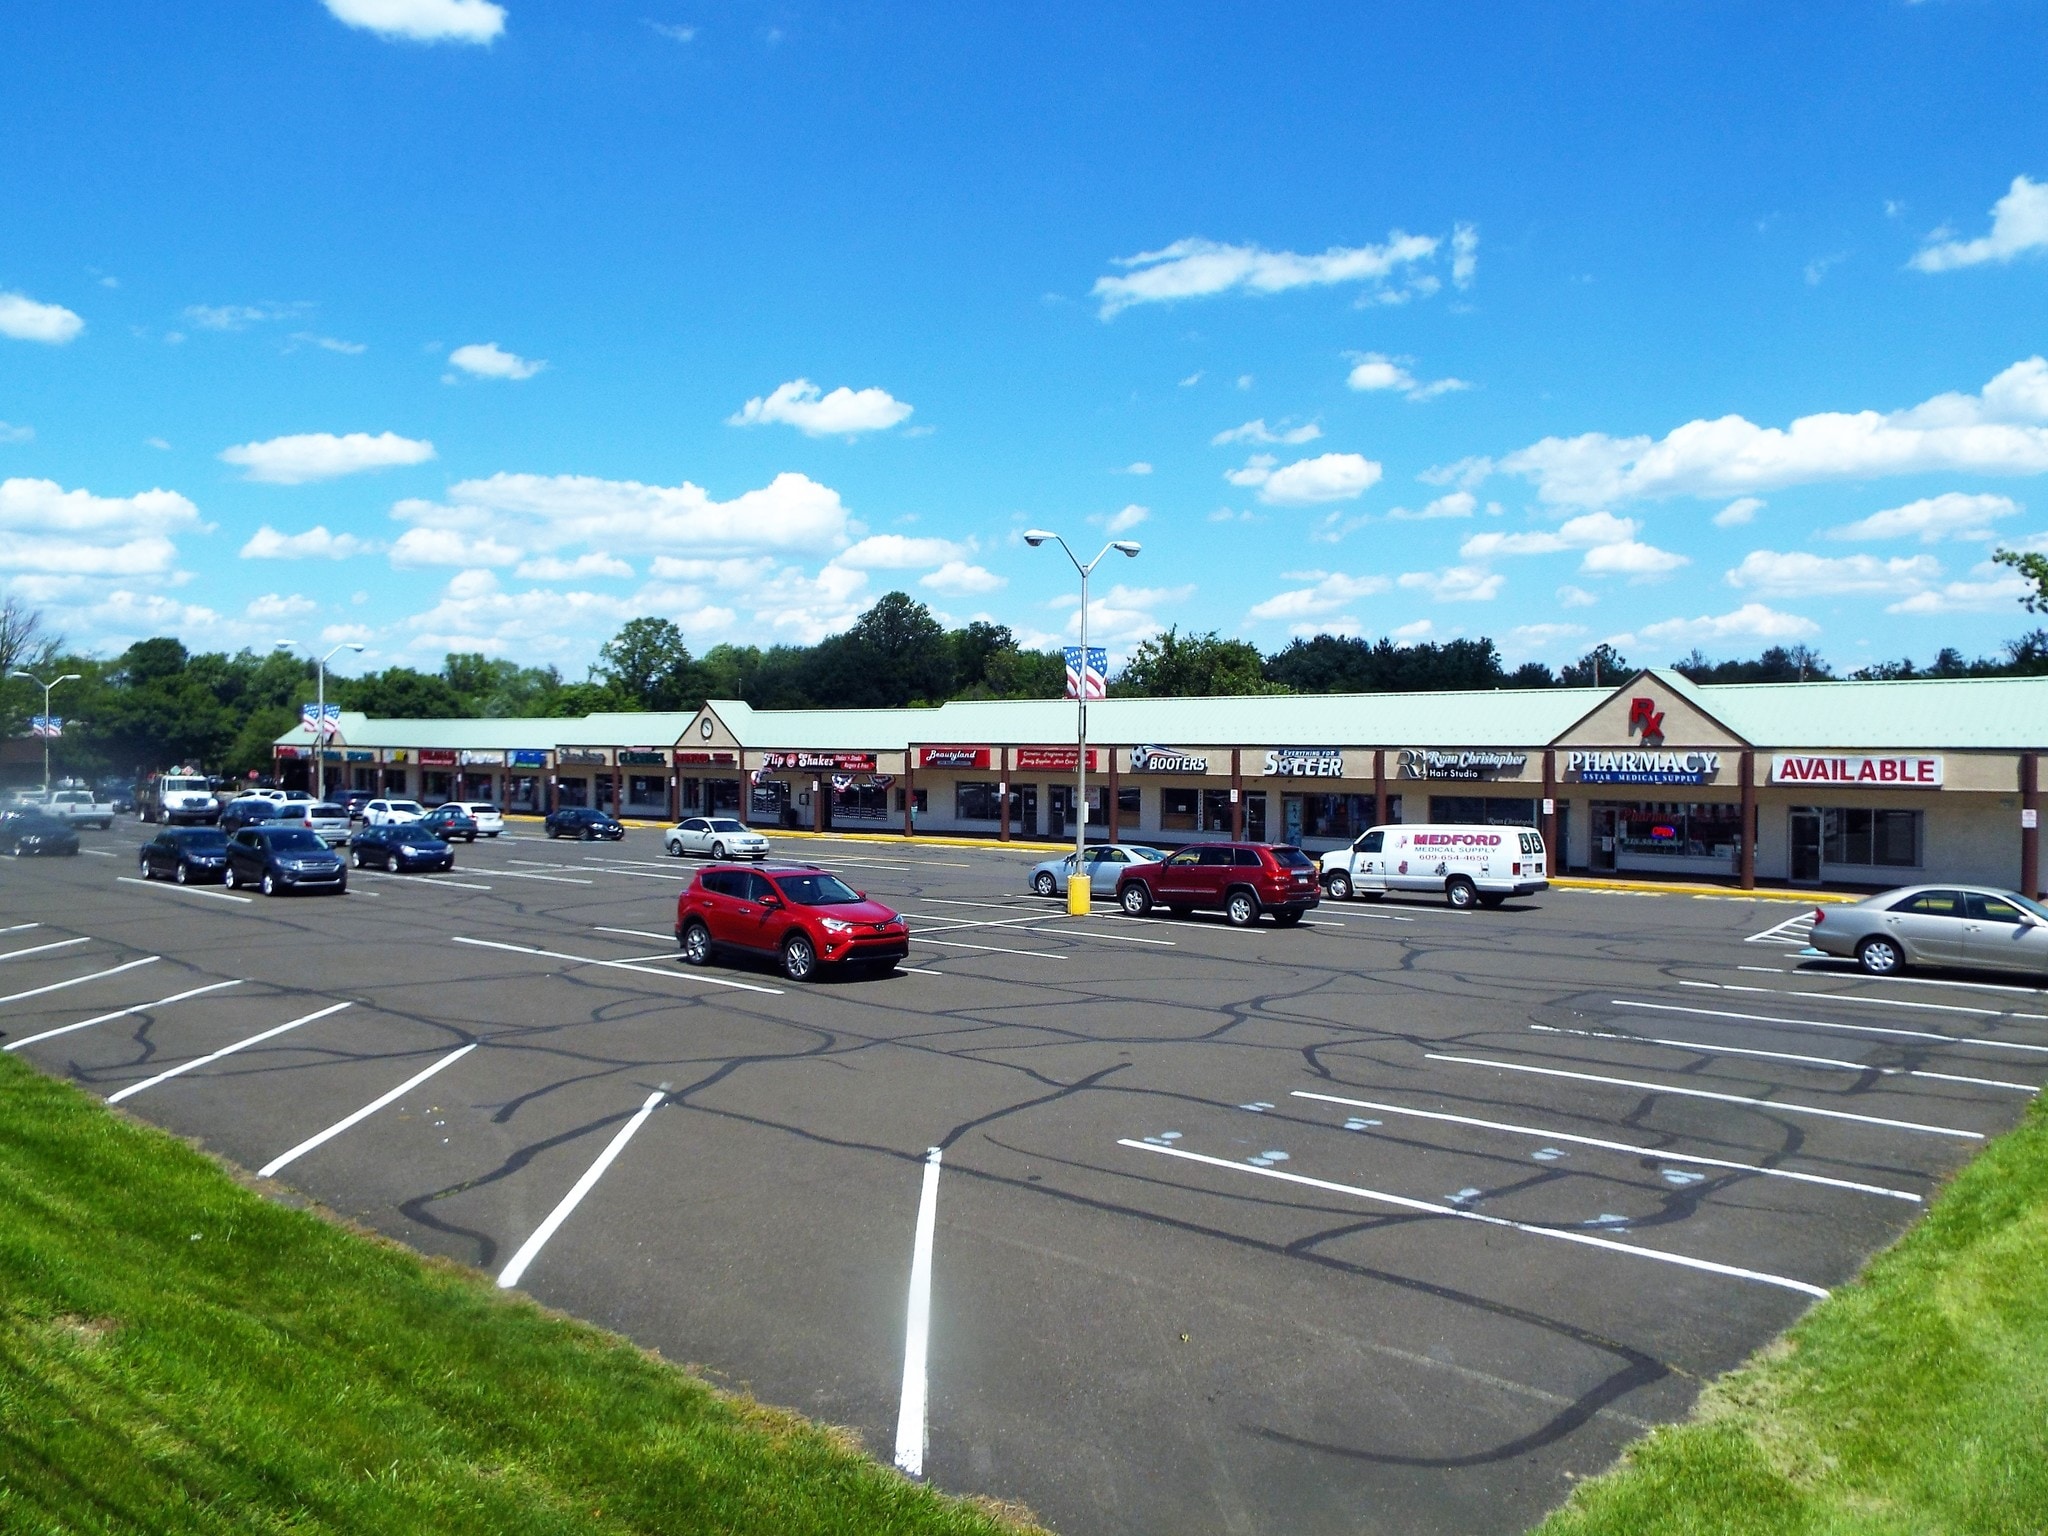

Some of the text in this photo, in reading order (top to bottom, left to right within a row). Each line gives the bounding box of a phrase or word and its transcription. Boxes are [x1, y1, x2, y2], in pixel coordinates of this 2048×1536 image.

[763, 753, 785, 768] Flip
[798, 753, 834, 767] Shakes
[926, 750, 976, 765] Beautyland
[1149, 757, 1207, 772] BOOTERS
[1428, 751, 1526, 769] Ryan Christopher
[1567, 751, 1718, 774] PHARMACY
[1429, 769, 1478, 778] Hair Studio
[1662, 774, 1698, 782] SUPPLY
[1779, 758, 1935, 783] AVAILABLE
[1413, 834, 1502, 846] MEDFORD
